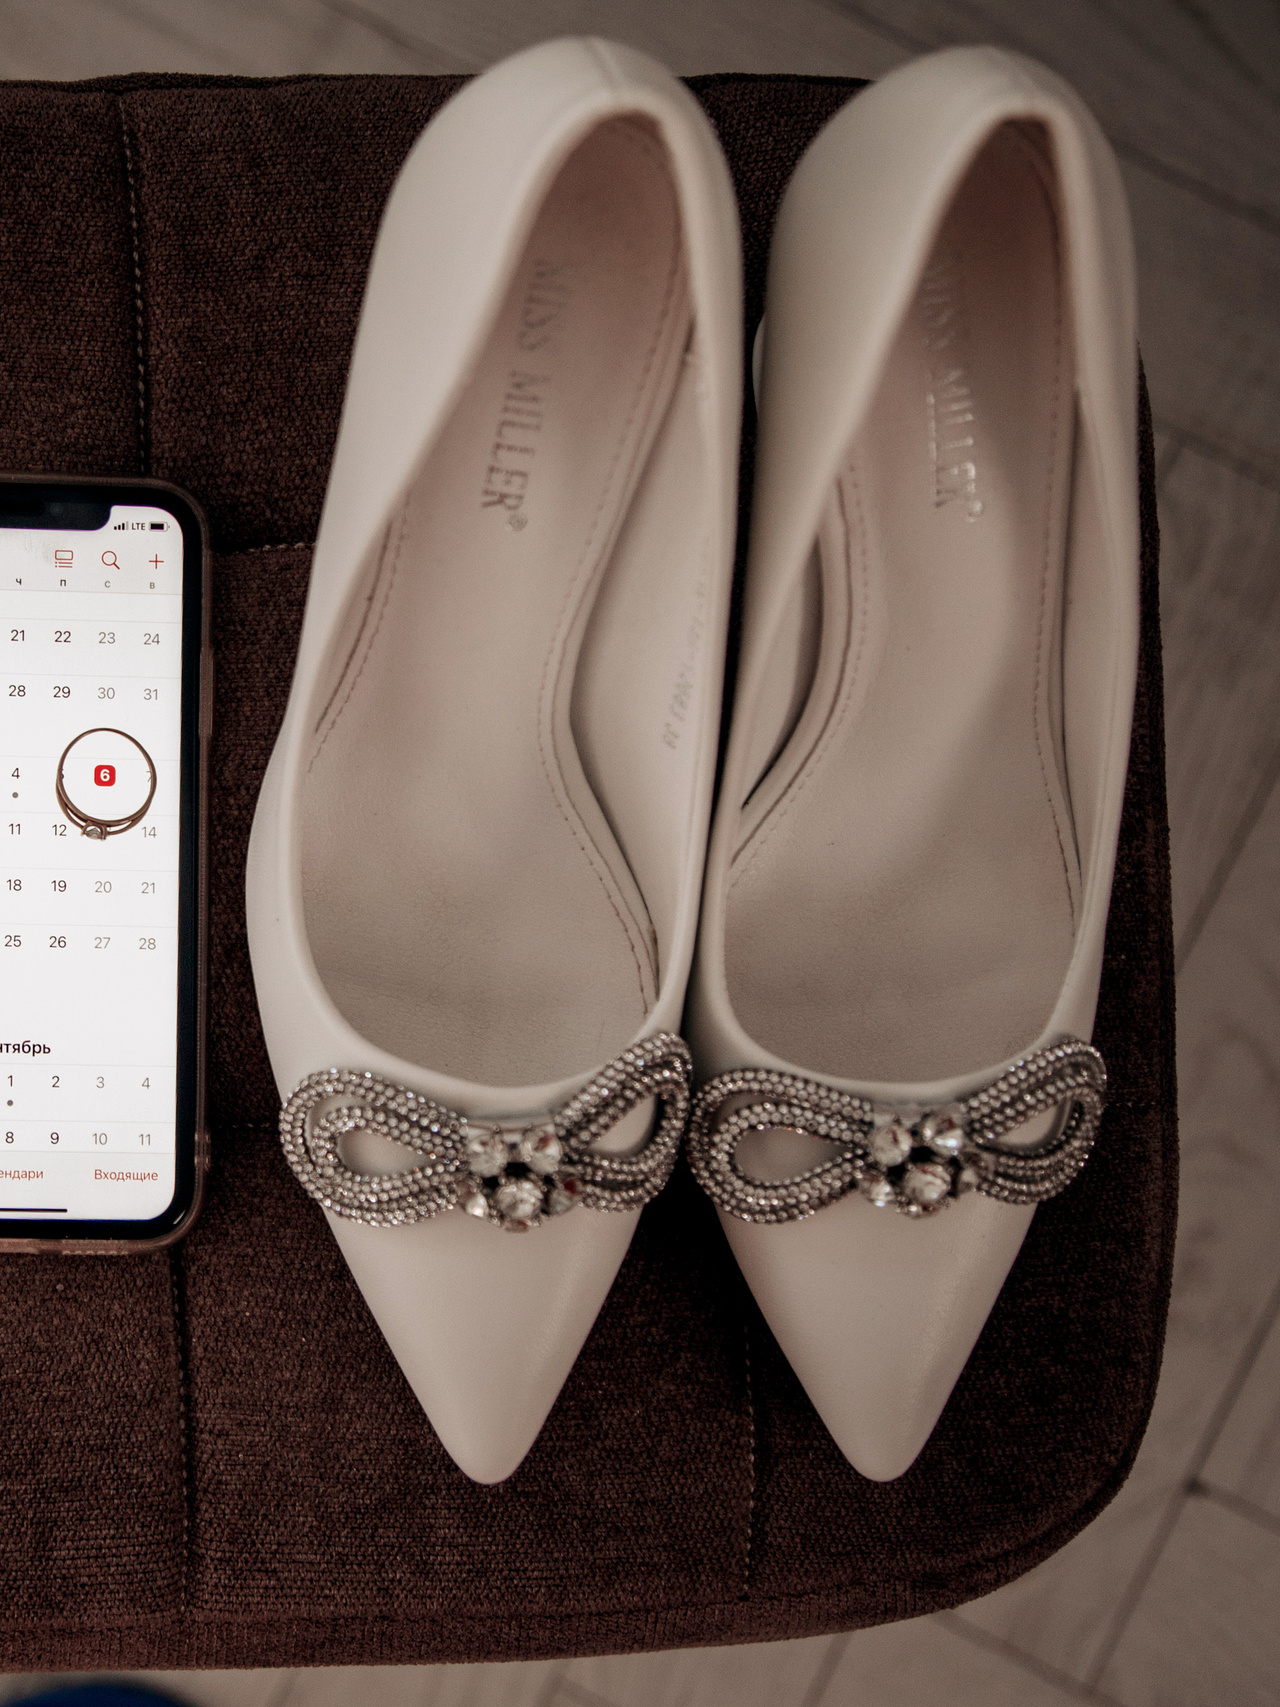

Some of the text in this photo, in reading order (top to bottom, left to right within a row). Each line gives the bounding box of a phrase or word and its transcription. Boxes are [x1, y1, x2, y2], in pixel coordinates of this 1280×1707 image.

[131, 521, 146, 532] LTE
[10, 628, 25, 642] 21
[54, 630, 72, 644] 22
[98, 631, 116, 645] 23
[143, 632, 161, 646] 24
[8, 684, 27, 698] 28
[52, 685, 71, 699] 29
[97, 686, 116, 700] 30
[143, 687, 158, 701] 31
[10, 767, 21, 780] 4
[100, 768, 110, 782] 6
[8, 822, 21, 836] 11
[51, 824, 67, 837] 12
[141, 826, 157, 839] 14
[6, 878, 23, 892] 18
[50, 879, 67, 893] 19
[94, 880, 113, 894] 20
[141, 881, 156, 895] 21
[4, 934, 22, 948] 25
[48, 935, 67, 949] 26
[94, 936, 111, 949] 27
[138, 937, 157, 951] 28
[7, 1074, 151, 1090] 1 2 3 4
[4, 1130, 15, 1145] 8
[49, 1131, 60, 1145] 9
[92, 1132, 108, 1146] 10
[138, 1133, 151, 1146] 11
[94, 1167, 159, 1183] Входящие
